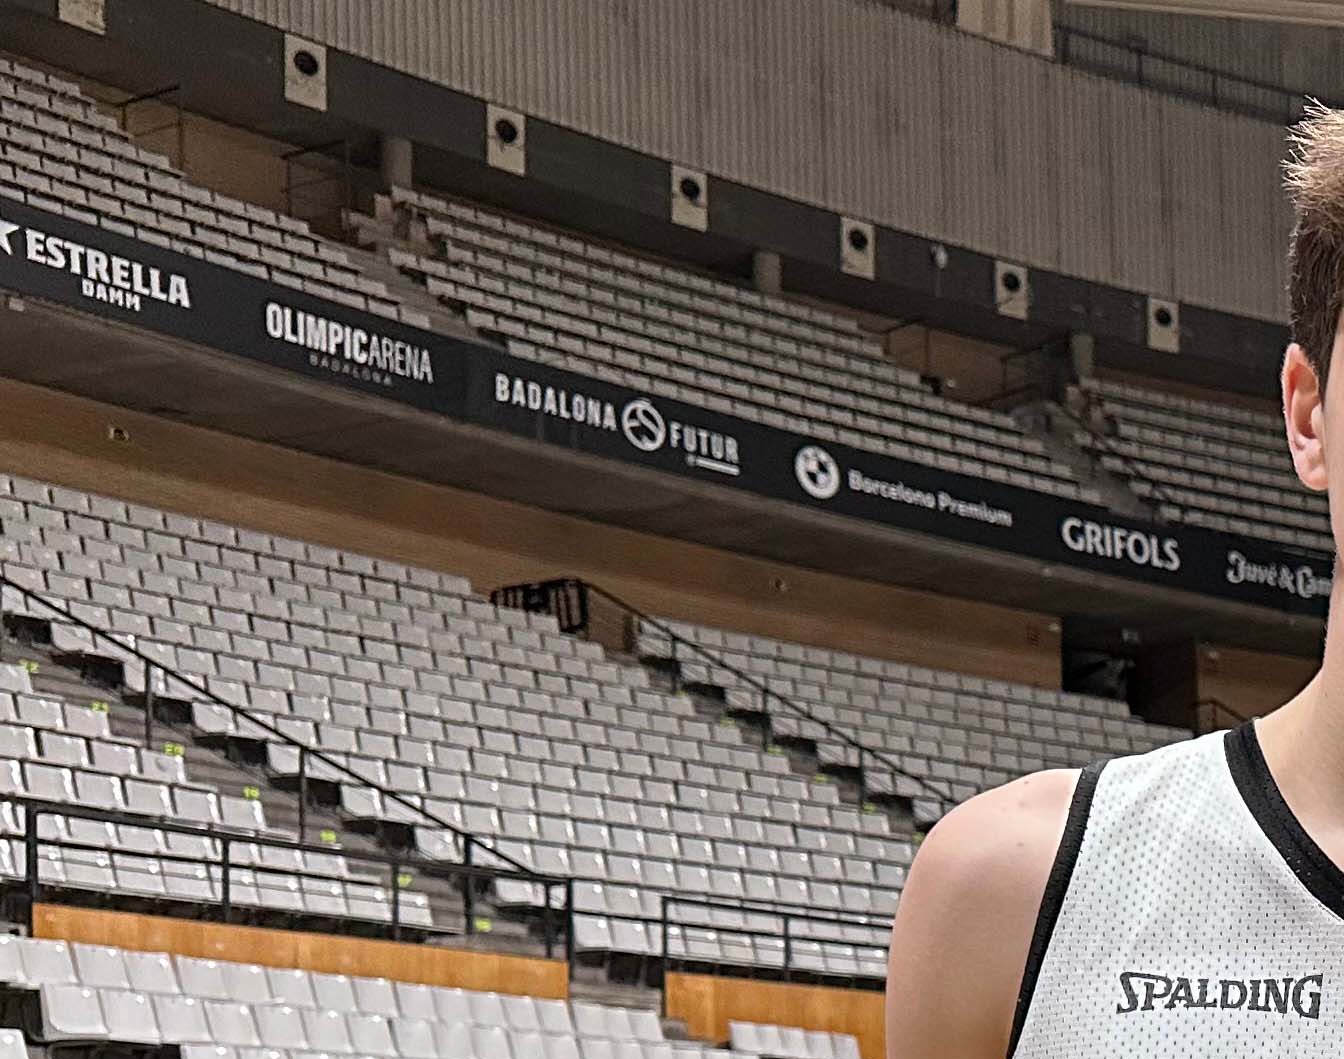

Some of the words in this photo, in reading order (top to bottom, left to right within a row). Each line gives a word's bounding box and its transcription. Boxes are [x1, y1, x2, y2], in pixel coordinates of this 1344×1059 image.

[25, 227, 191, 309] ESTRELLA
[81, 277, 141, 312] DAMM
[495, 372, 617, 432] BADALONA
[669, 421, 740, 464] FUTUR
[848, 468, 936, 509] Barcelona
[937, 490, 1013, 527] Premium
[1061, 516, 1181, 571] GRIFOLS
[1116, 971, 1324, 1019] SPALDING
